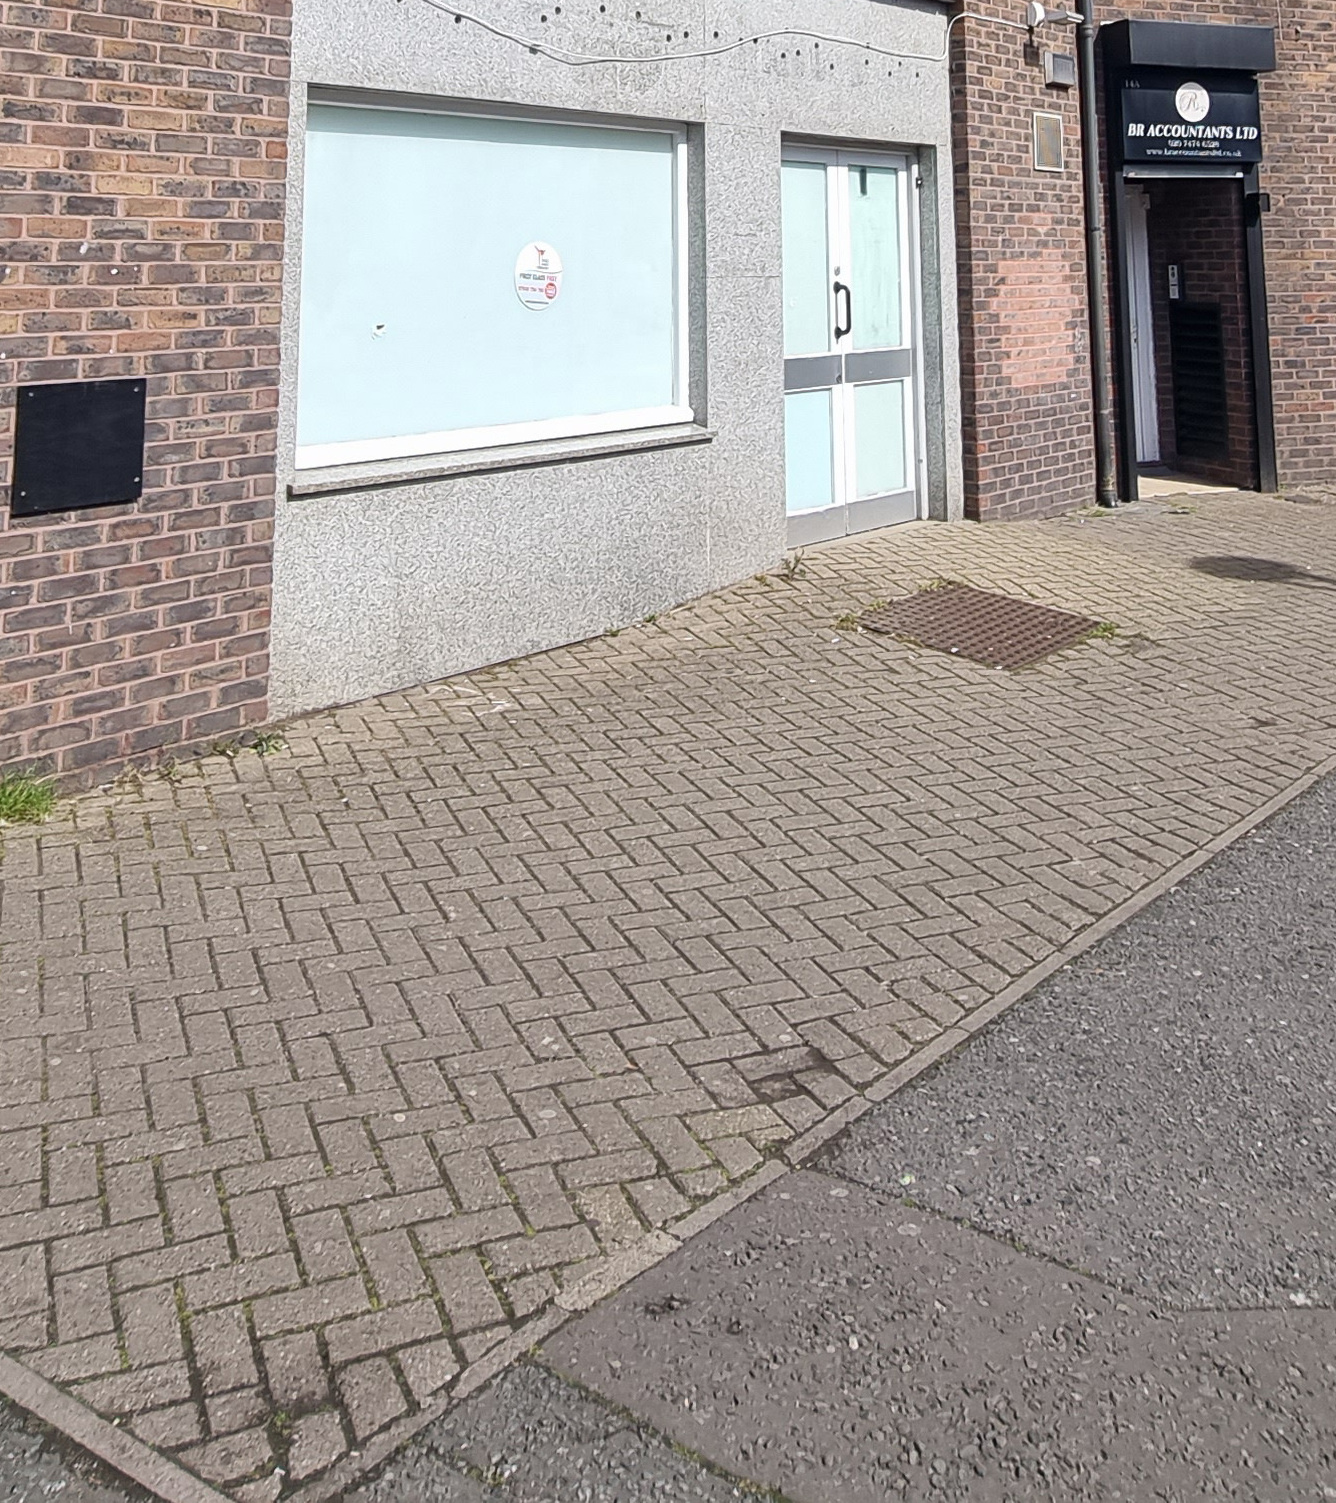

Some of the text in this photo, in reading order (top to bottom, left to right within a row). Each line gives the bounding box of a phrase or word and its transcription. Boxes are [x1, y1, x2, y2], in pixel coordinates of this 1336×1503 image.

[1128, 123, 1258, 140] BR ACCOUNTANTS LTD
